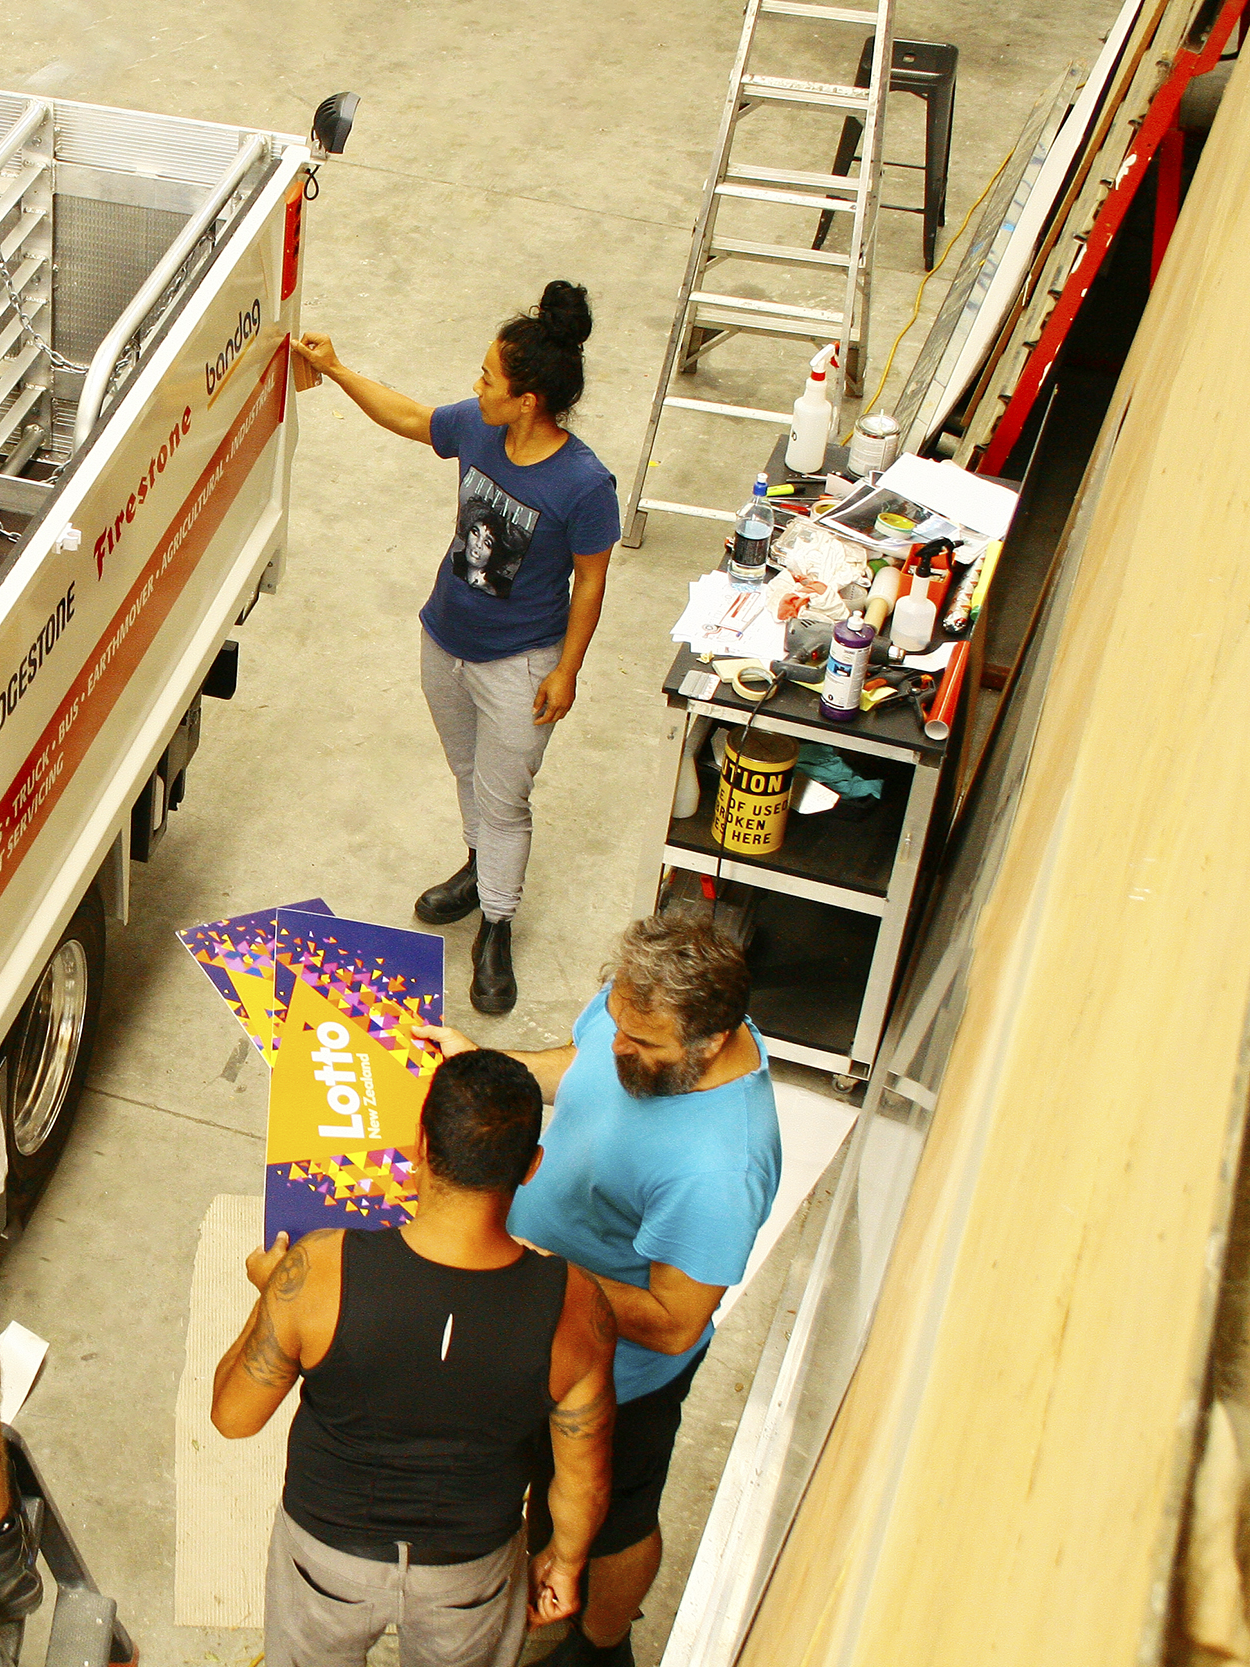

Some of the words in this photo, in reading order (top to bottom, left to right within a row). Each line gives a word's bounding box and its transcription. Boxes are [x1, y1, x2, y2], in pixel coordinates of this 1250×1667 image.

[205, 298, 262, 396] bandag
[93, 405, 192, 582] Firestone
[12, 744, 50, 818] TRUCK
[58, 697, 79, 745] BUS
[87, 574, 155, 697] EARTHMOVER
[161, 460, 224, 576] AGRICULTURAL
[6, 751, 65, 860] SERVICING
[722, 758, 784, 793] UTION
[752, 799, 789, 816] USED
[731, 829, 772, 845] HERE
[311, 1021, 366, 1139] Lotto
[356, 1053, 377, 1106] Zealand
[368, 1108, 382, 1139] New
